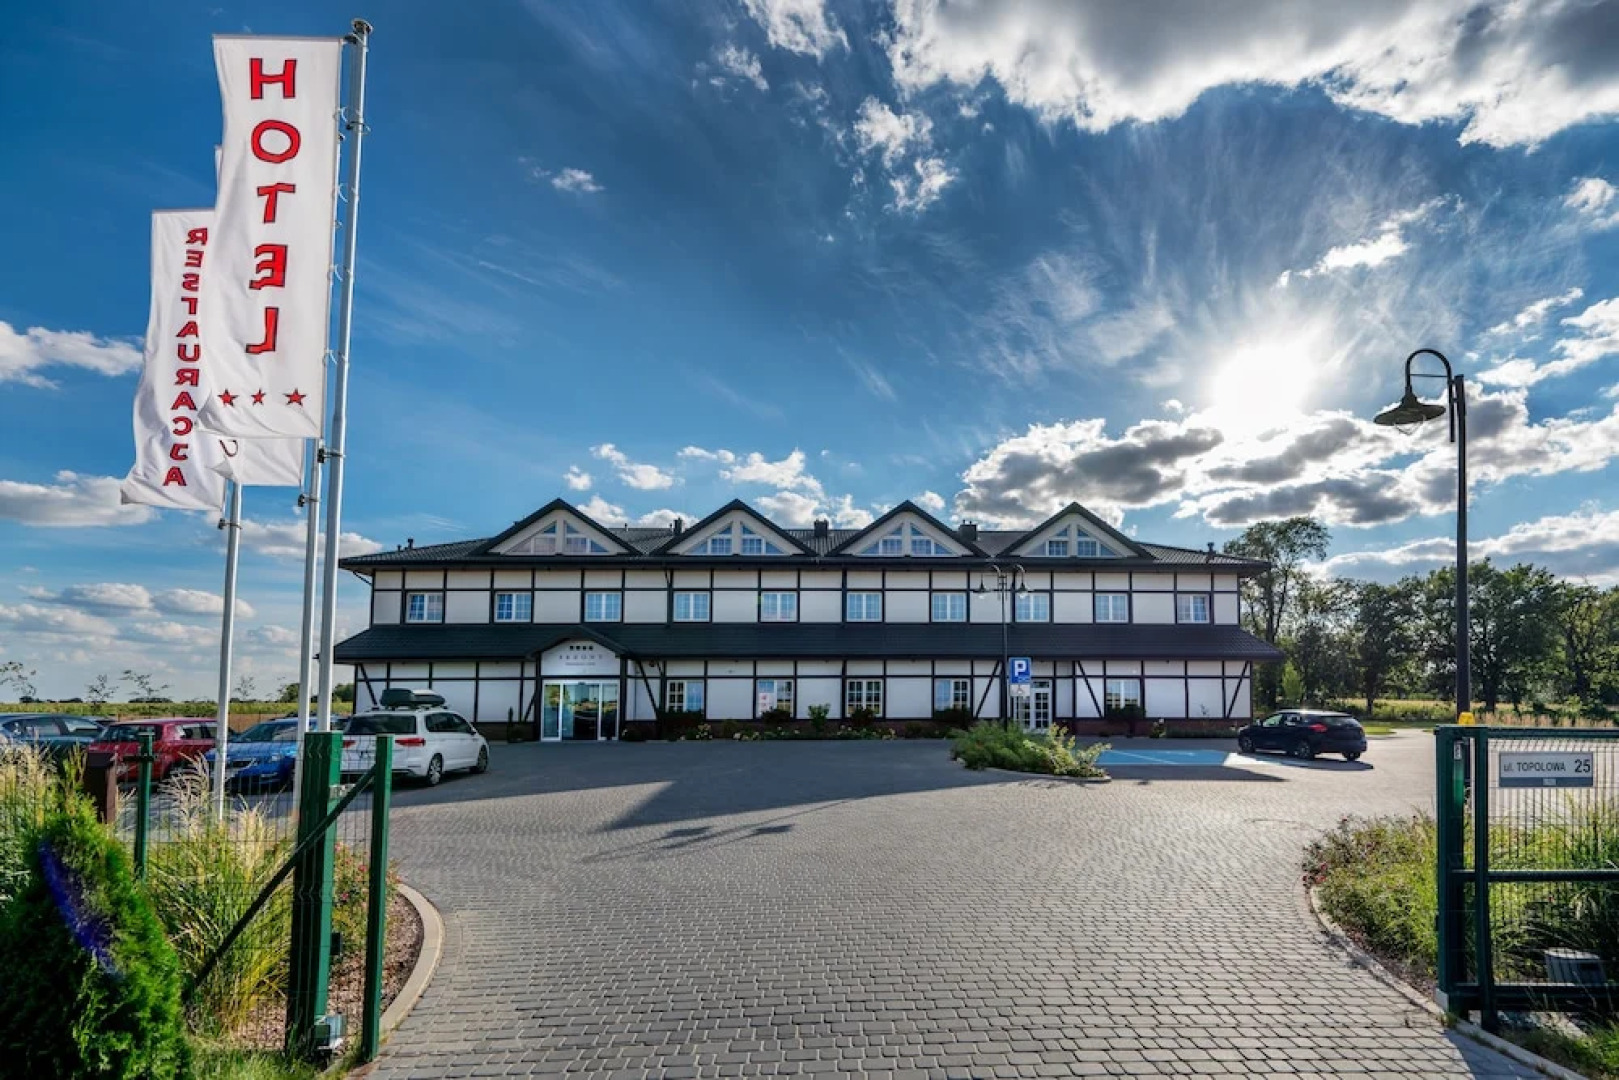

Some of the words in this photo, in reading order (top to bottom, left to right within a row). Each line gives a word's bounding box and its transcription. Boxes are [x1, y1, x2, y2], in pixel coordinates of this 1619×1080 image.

[1014, 660, 1027, 677] P
[1516, 762, 1566, 772] TOPOLOWA
[1574, 759, 1591, 773] 25
